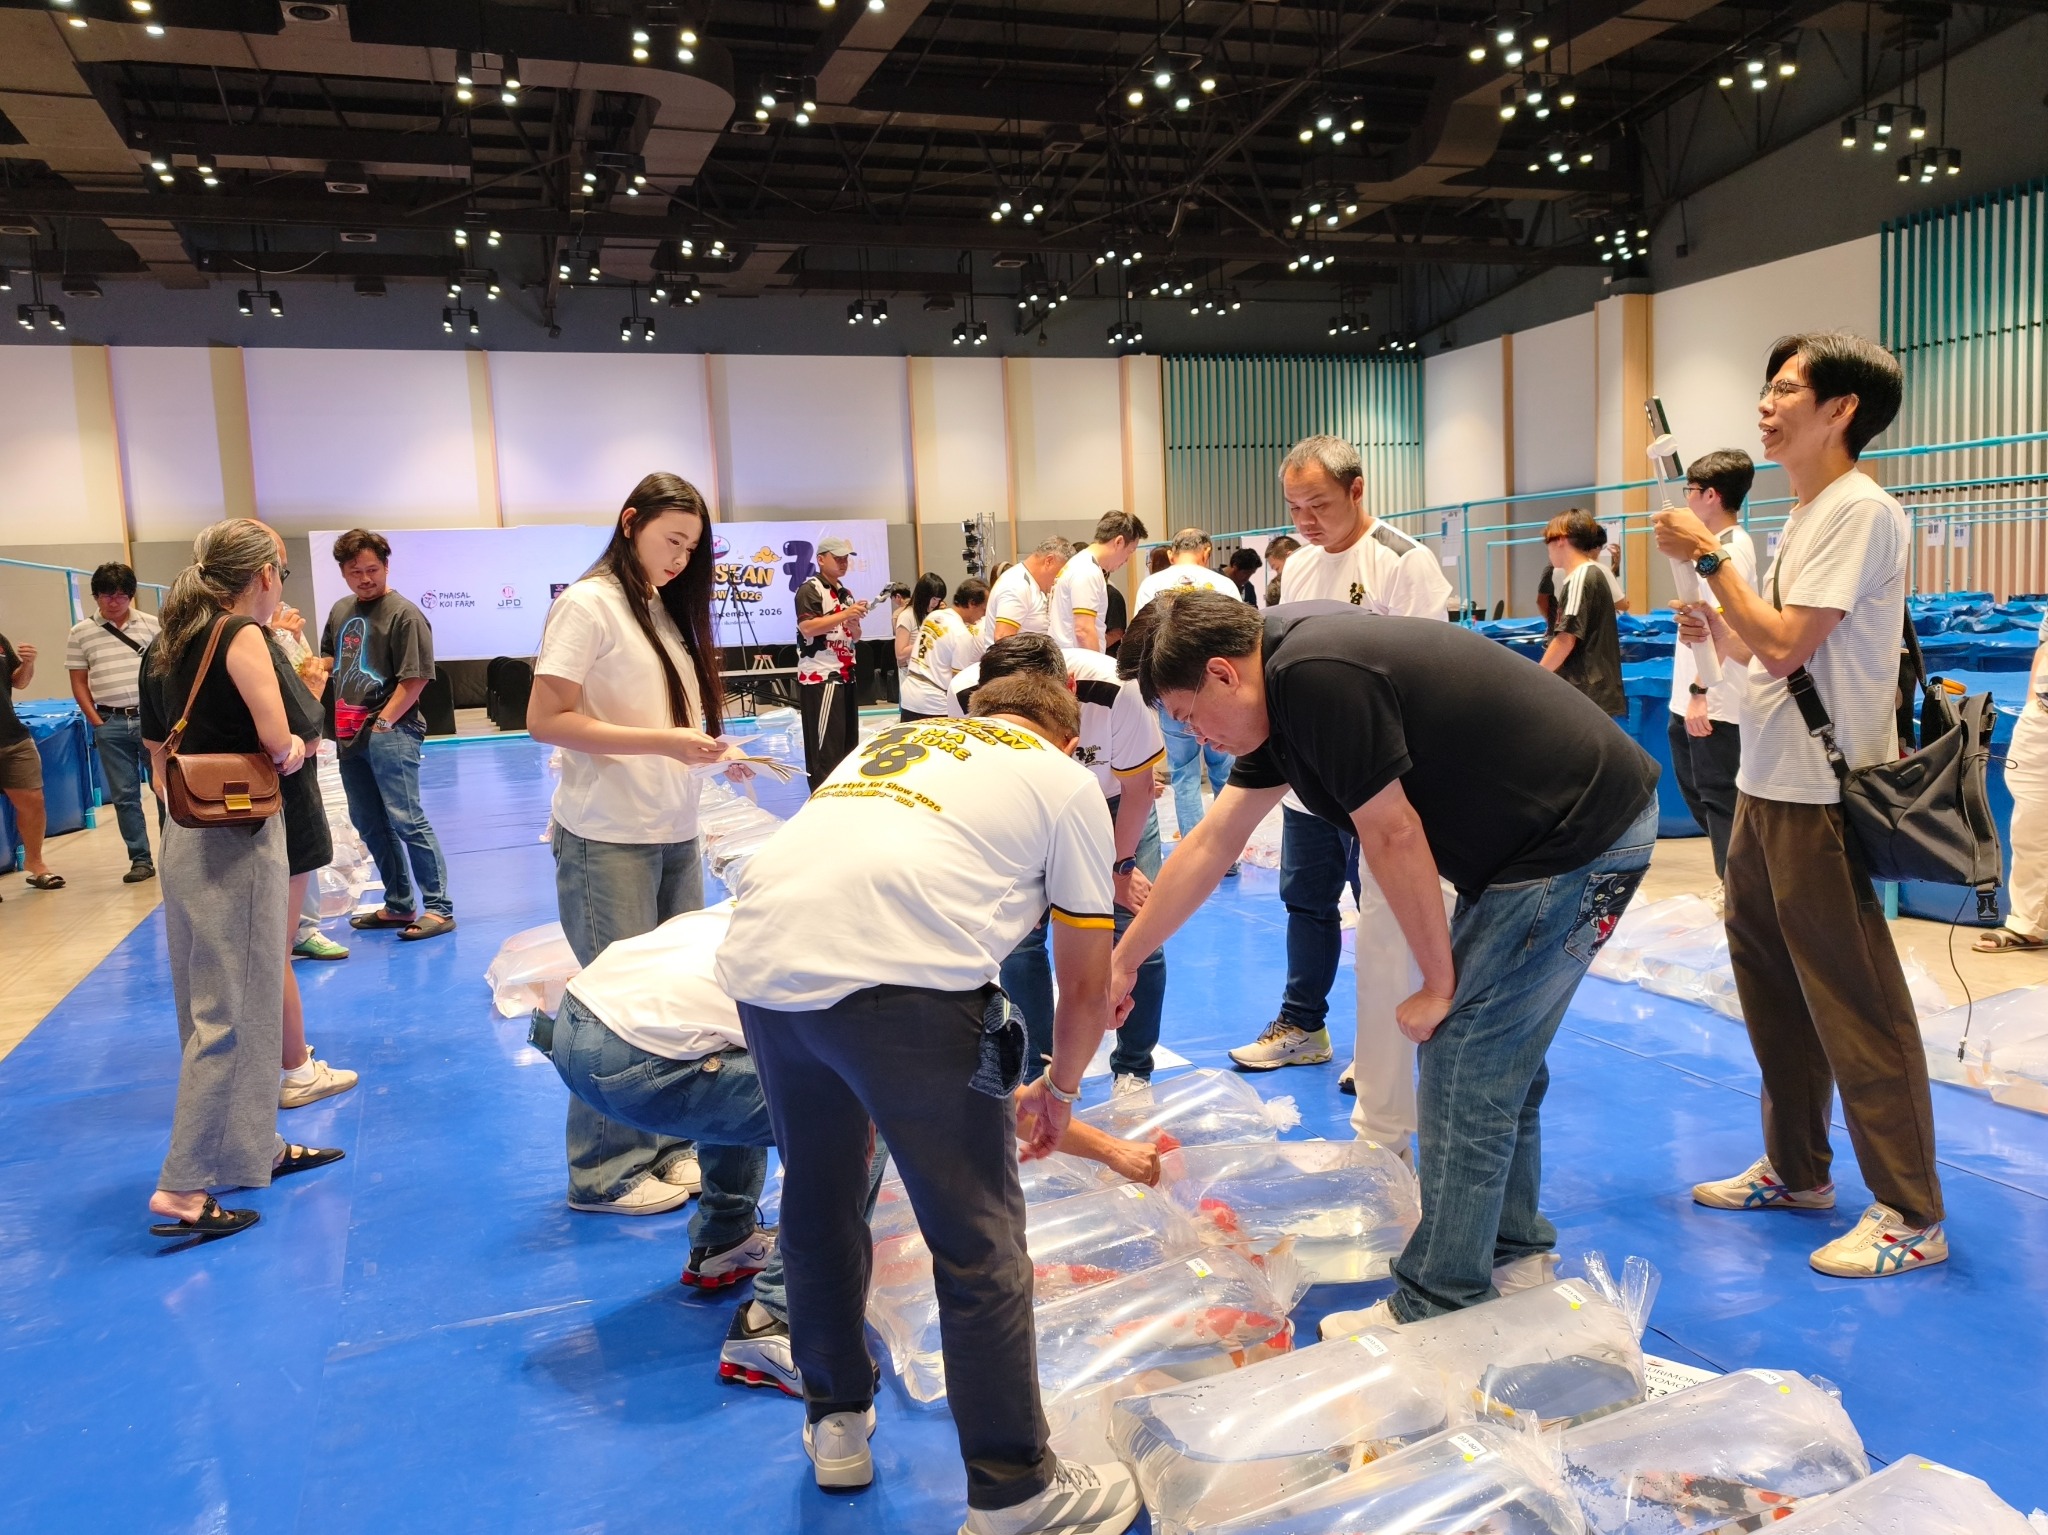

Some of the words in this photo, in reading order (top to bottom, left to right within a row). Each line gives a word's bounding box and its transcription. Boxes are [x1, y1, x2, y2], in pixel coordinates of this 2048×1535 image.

[714, 563, 775, 588] SEAN
[439, 600, 453, 608] KOI
[455, 600, 475, 608] FARM
[497, 599, 521, 607] JPD
[710, 590, 728, 601] OW
[731, 590, 763, 602] 026
[759, 608, 782, 616] 2026
[920, 728, 966, 744] MA
[911, 734, 972, 761] TURE
[885, 782, 912, 796] Show
[914, 793, 942, 813] 2026
[1644, 1366, 1703, 1385] URIMON
[1645, 1373, 1691, 1390] YOMO
